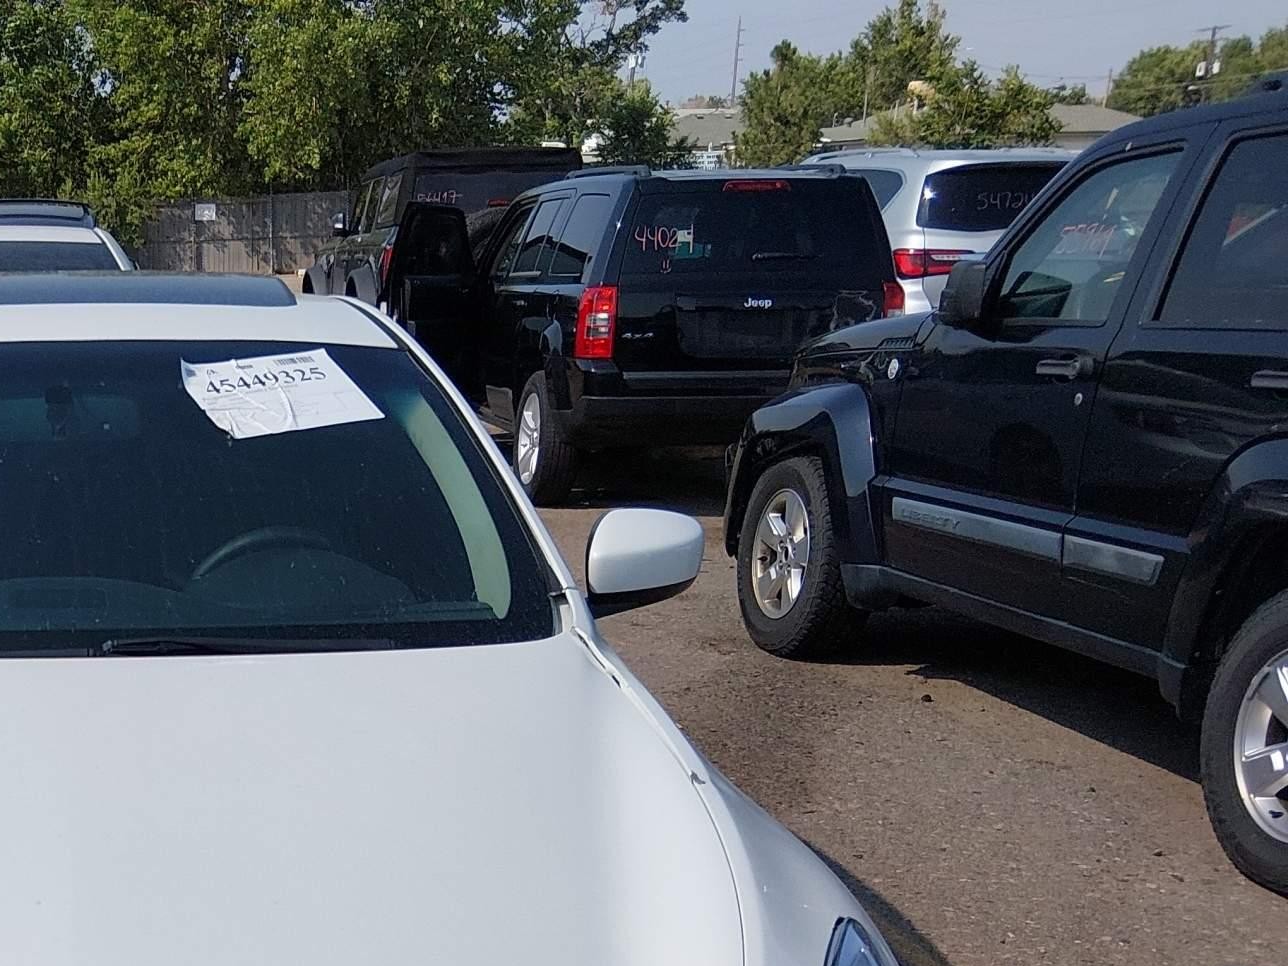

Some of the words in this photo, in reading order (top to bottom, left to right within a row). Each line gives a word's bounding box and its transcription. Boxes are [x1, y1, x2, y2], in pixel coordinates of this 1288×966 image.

[634, 223, 695, 254] 44024
[744, 297, 773, 309] Jeep
[207, 367, 326, 393] 45449325
